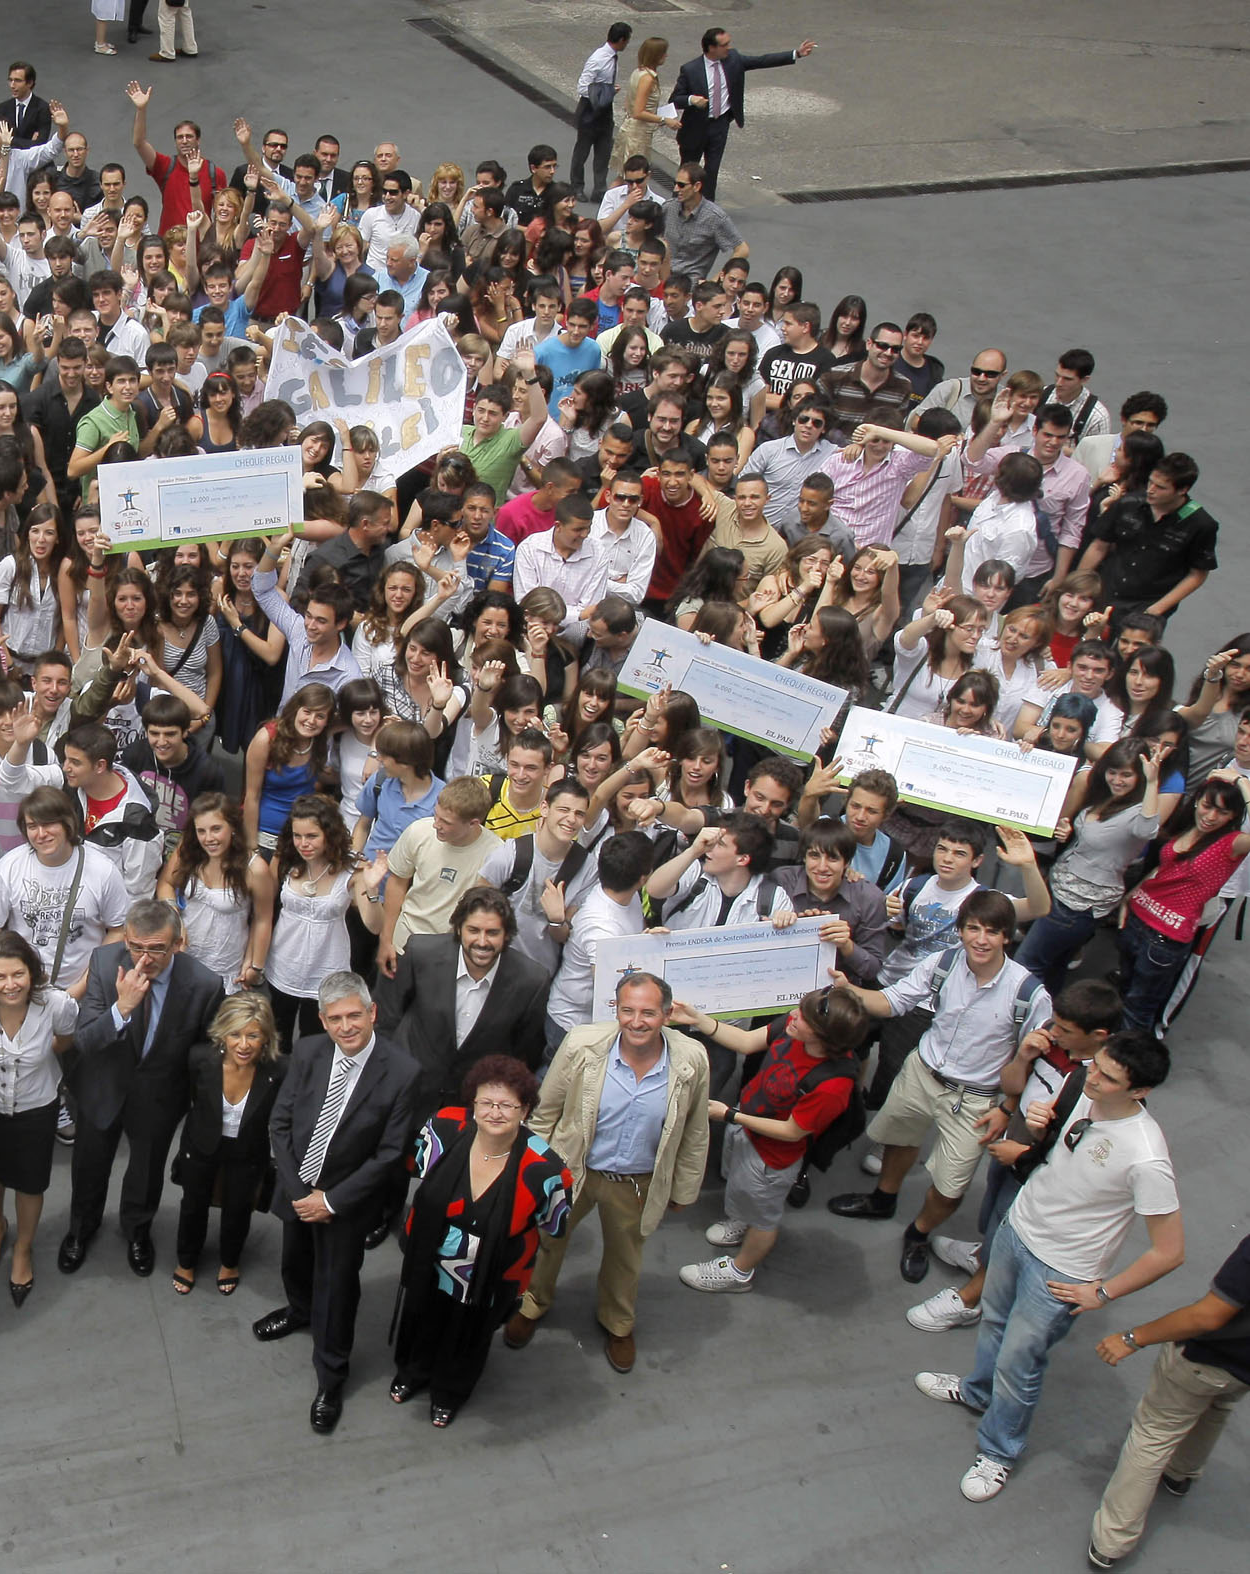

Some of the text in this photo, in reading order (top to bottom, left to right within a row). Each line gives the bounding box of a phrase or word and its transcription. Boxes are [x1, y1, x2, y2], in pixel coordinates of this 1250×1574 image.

[770, 359, 795, 379] SEX
[278, 344, 464, 415] GALILEO
[234, 454, 294, 468] CHEQUE REGALO
[774, 673, 805, 690] CHEQUE
[805, 684, 837, 703] REGALO
[765, 729, 777, 739] EL
[995, 747, 1066, 770] CHEQUE REGALO
[996, 806, 1009, 815] EL
[688, 937, 713, 945] ENDESA
[771, 929, 791, 937] Medio
